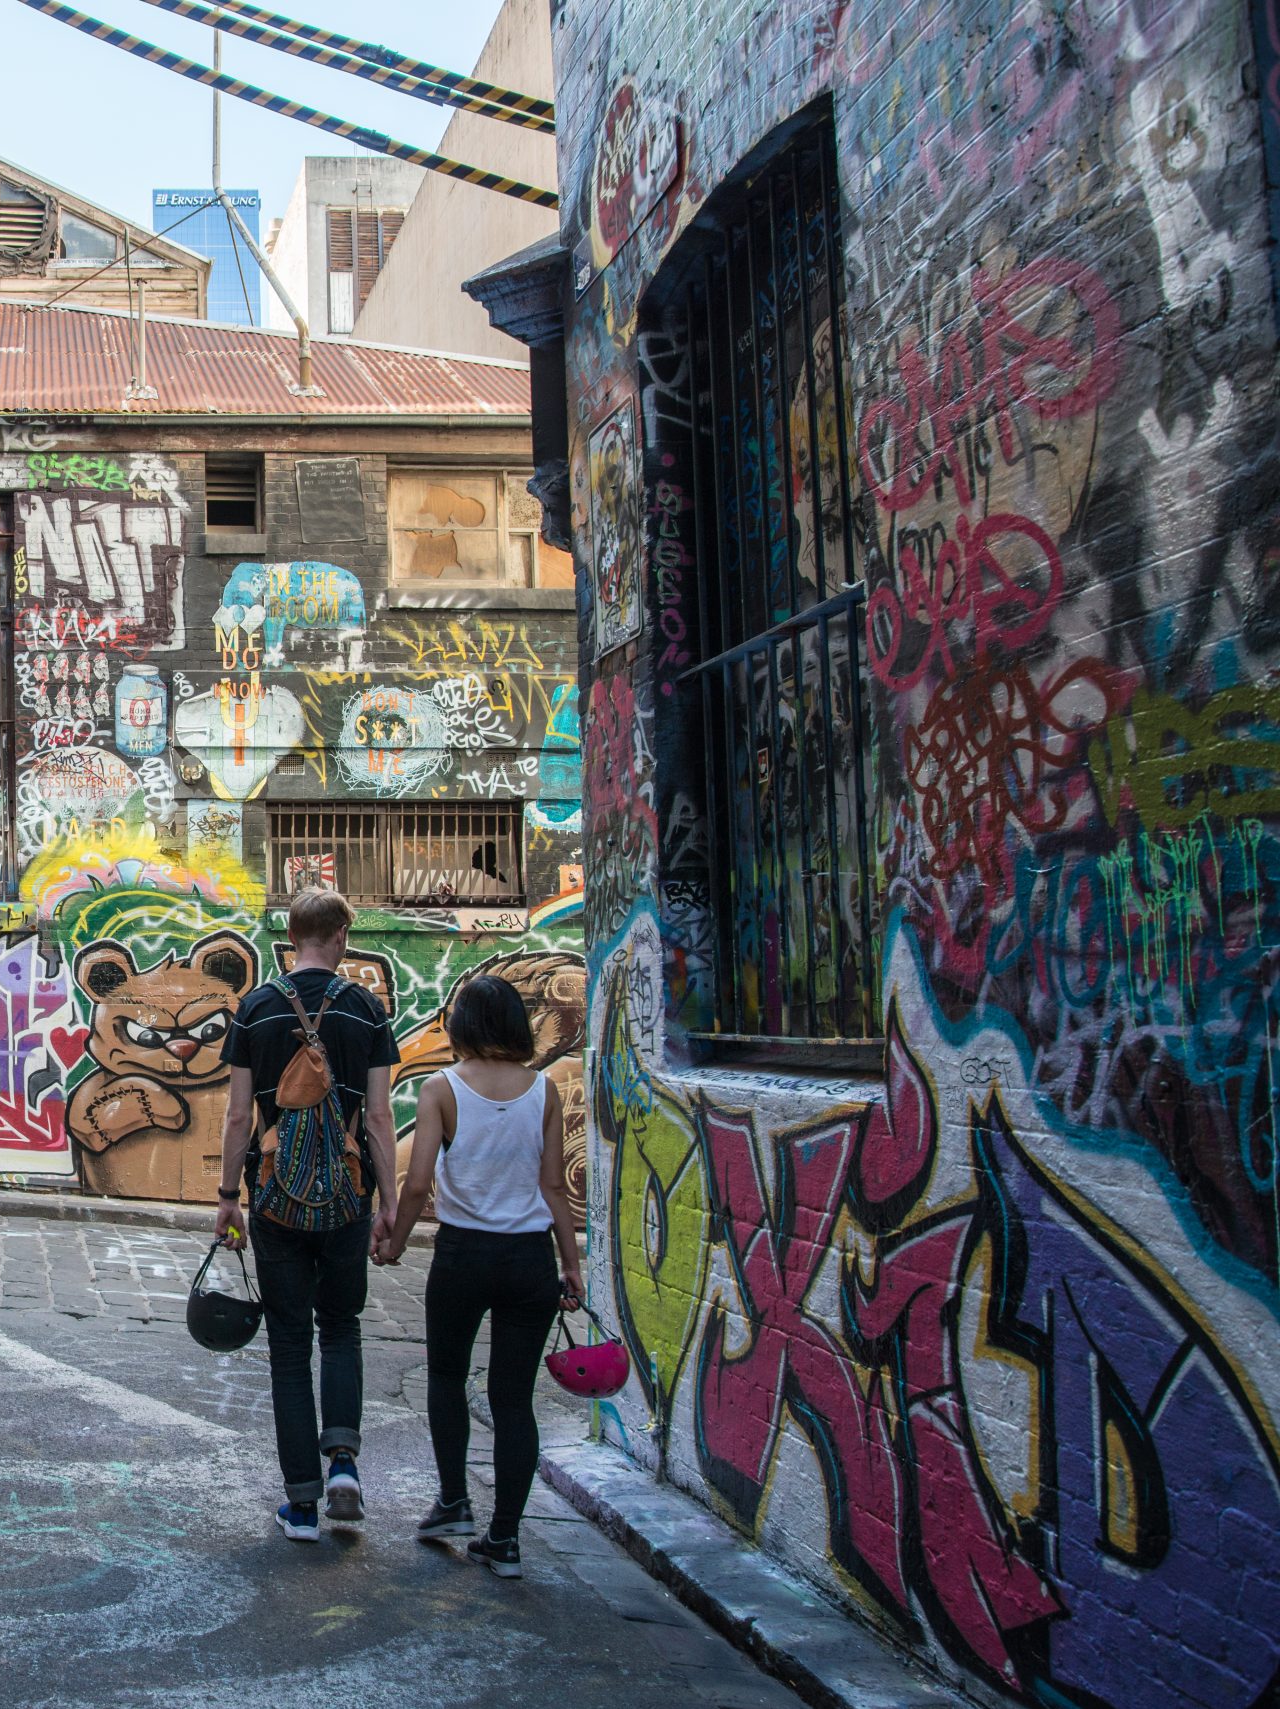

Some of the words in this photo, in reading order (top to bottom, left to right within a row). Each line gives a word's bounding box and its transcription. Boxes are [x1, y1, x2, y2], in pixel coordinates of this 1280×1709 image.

[171, 194, 205, 206] ERNST
[270, 571, 290, 596] IN
[297, 570, 338, 596] THE
[222, 647, 259, 671] DO
[213, 682, 267, 699] KNOW
[362, 693, 416, 712] DON'T
